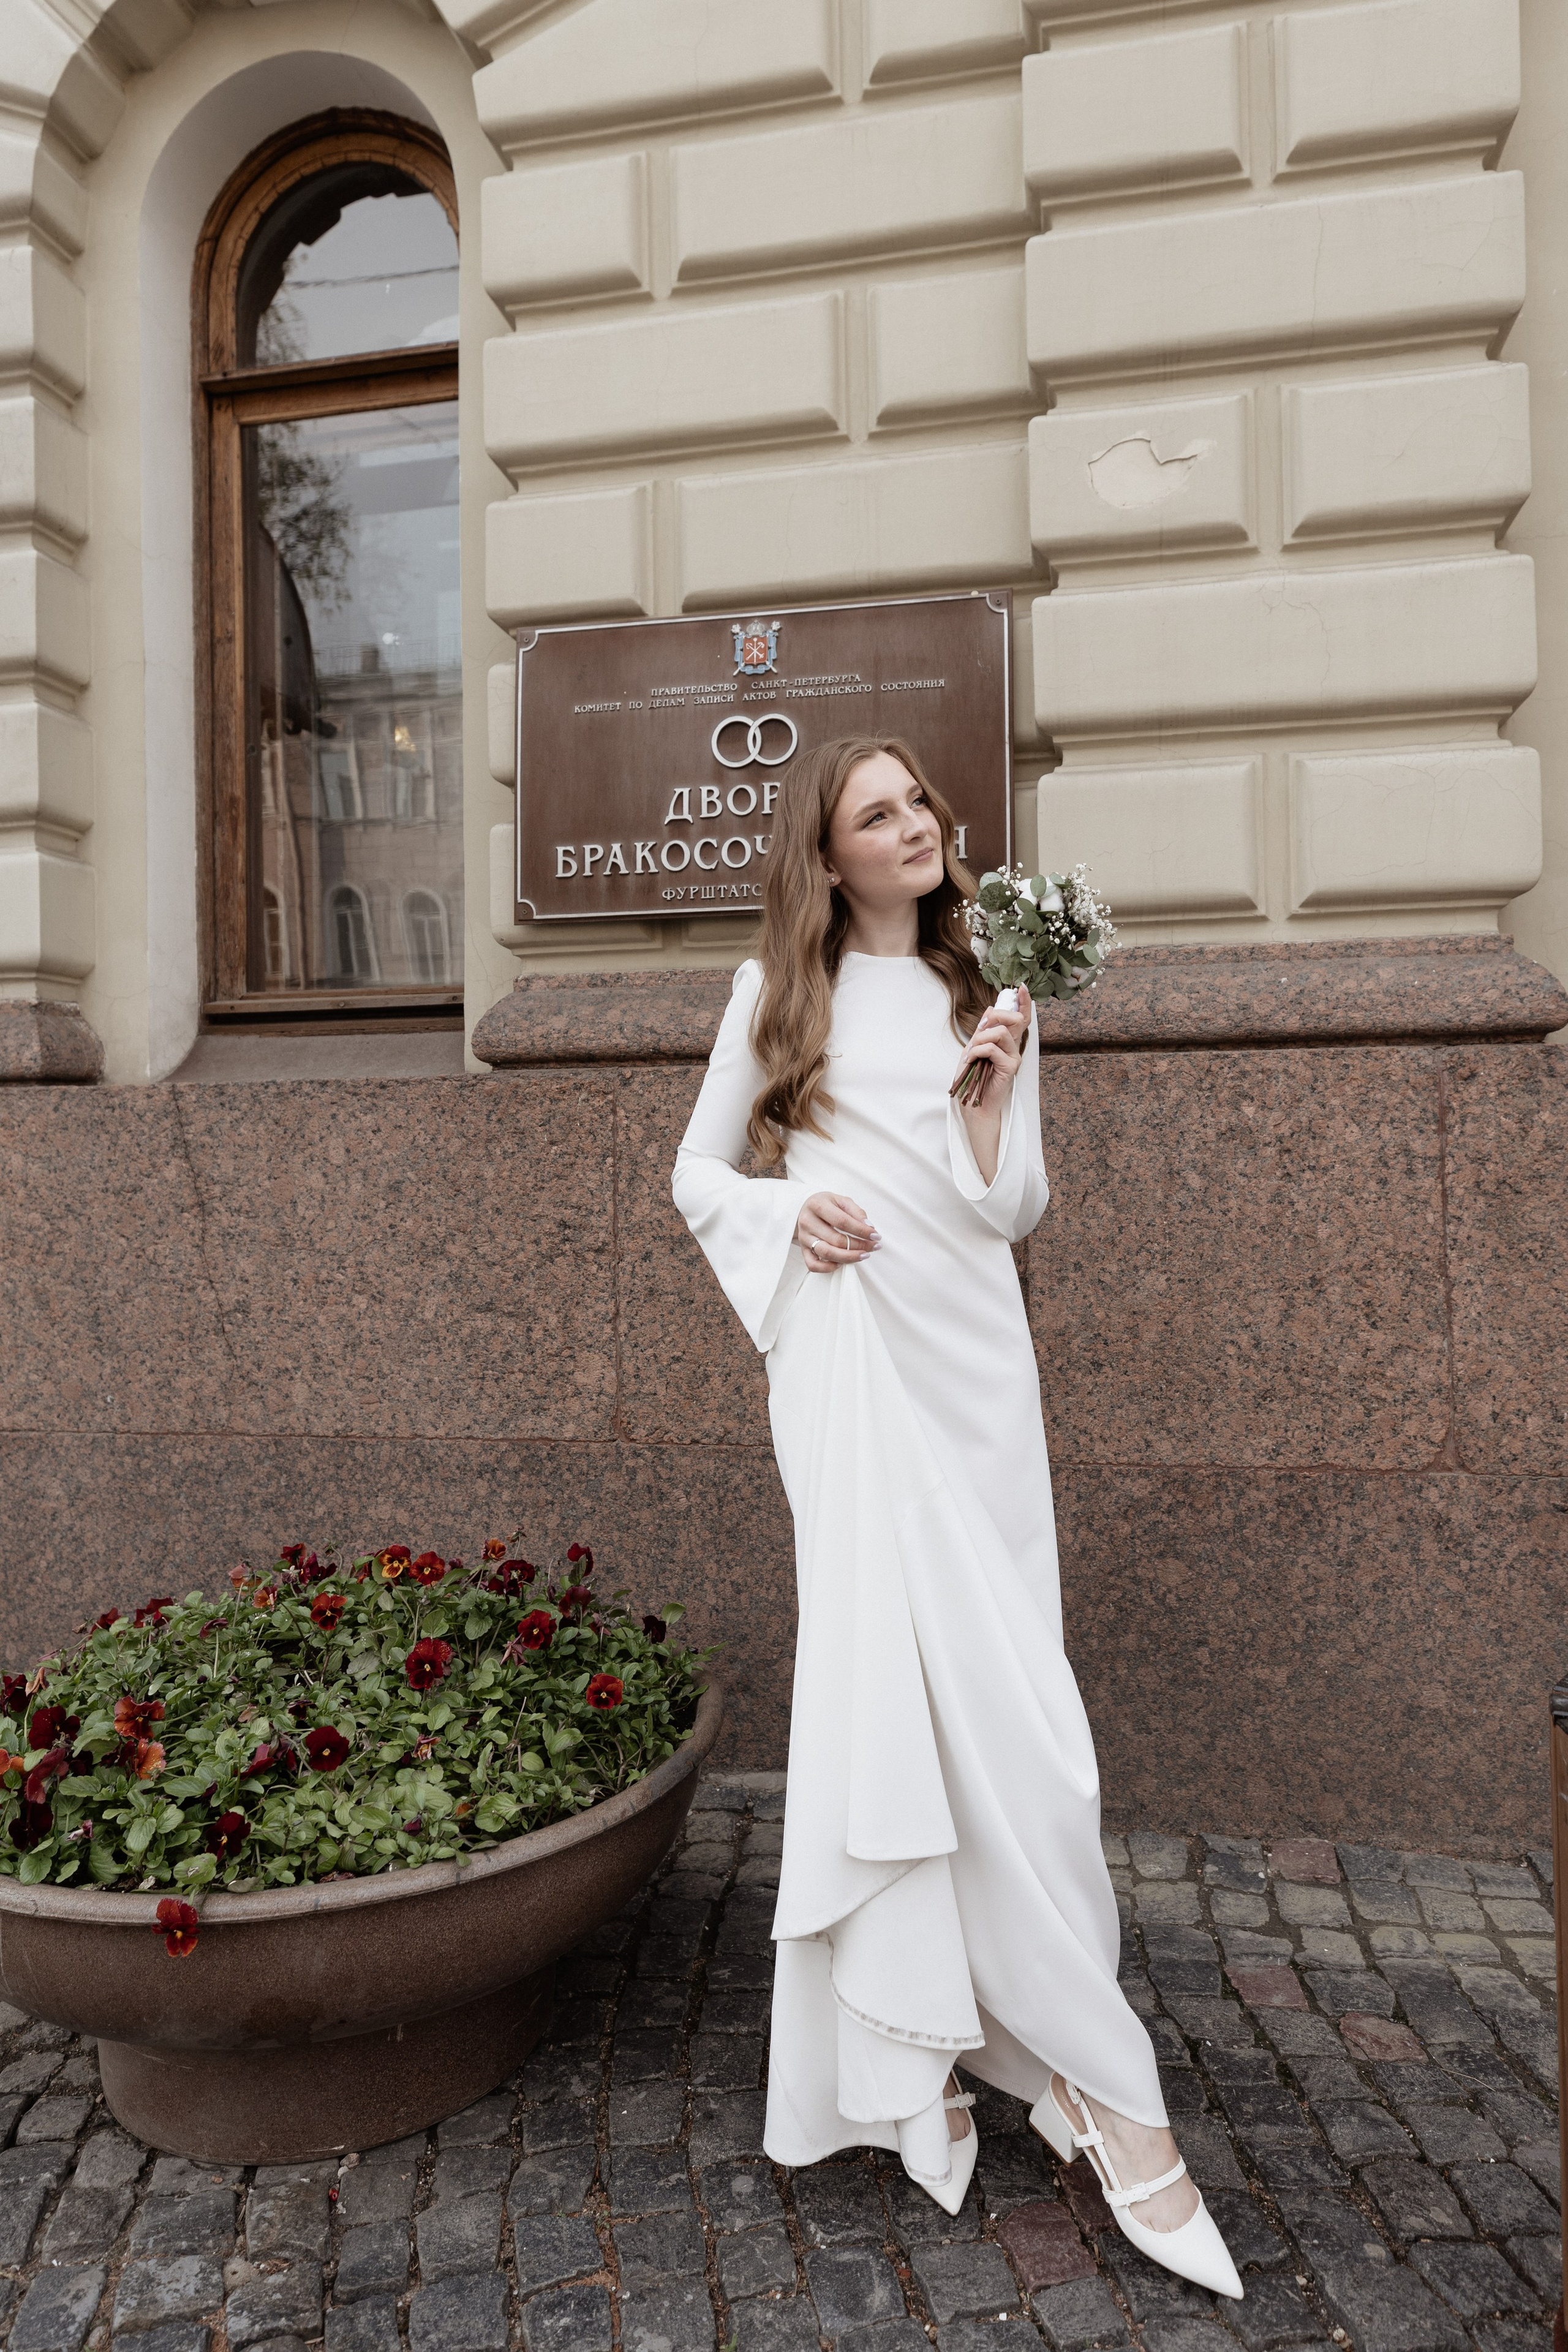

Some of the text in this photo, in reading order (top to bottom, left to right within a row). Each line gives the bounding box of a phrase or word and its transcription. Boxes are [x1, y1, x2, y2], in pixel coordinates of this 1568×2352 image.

[575, 703, 621, 714] КОМИТЕТ
[649, 698, 685, 709] ДЕЛАМ
[693, 695, 734, 705] ЗАПИСИ
[742, 691, 777, 701] АКТОВ
[786, 684, 872, 698] ГРАЖДАНСКОГО
[881, 679, 945, 691] СОСТОЯНИЯ
[652, 683, 737, 696] ПРАВИТЕЛЬСТВО
[665, 782, 781, 824] ДВОР
[662, 884, 762, 900] ФУРШТАТС
